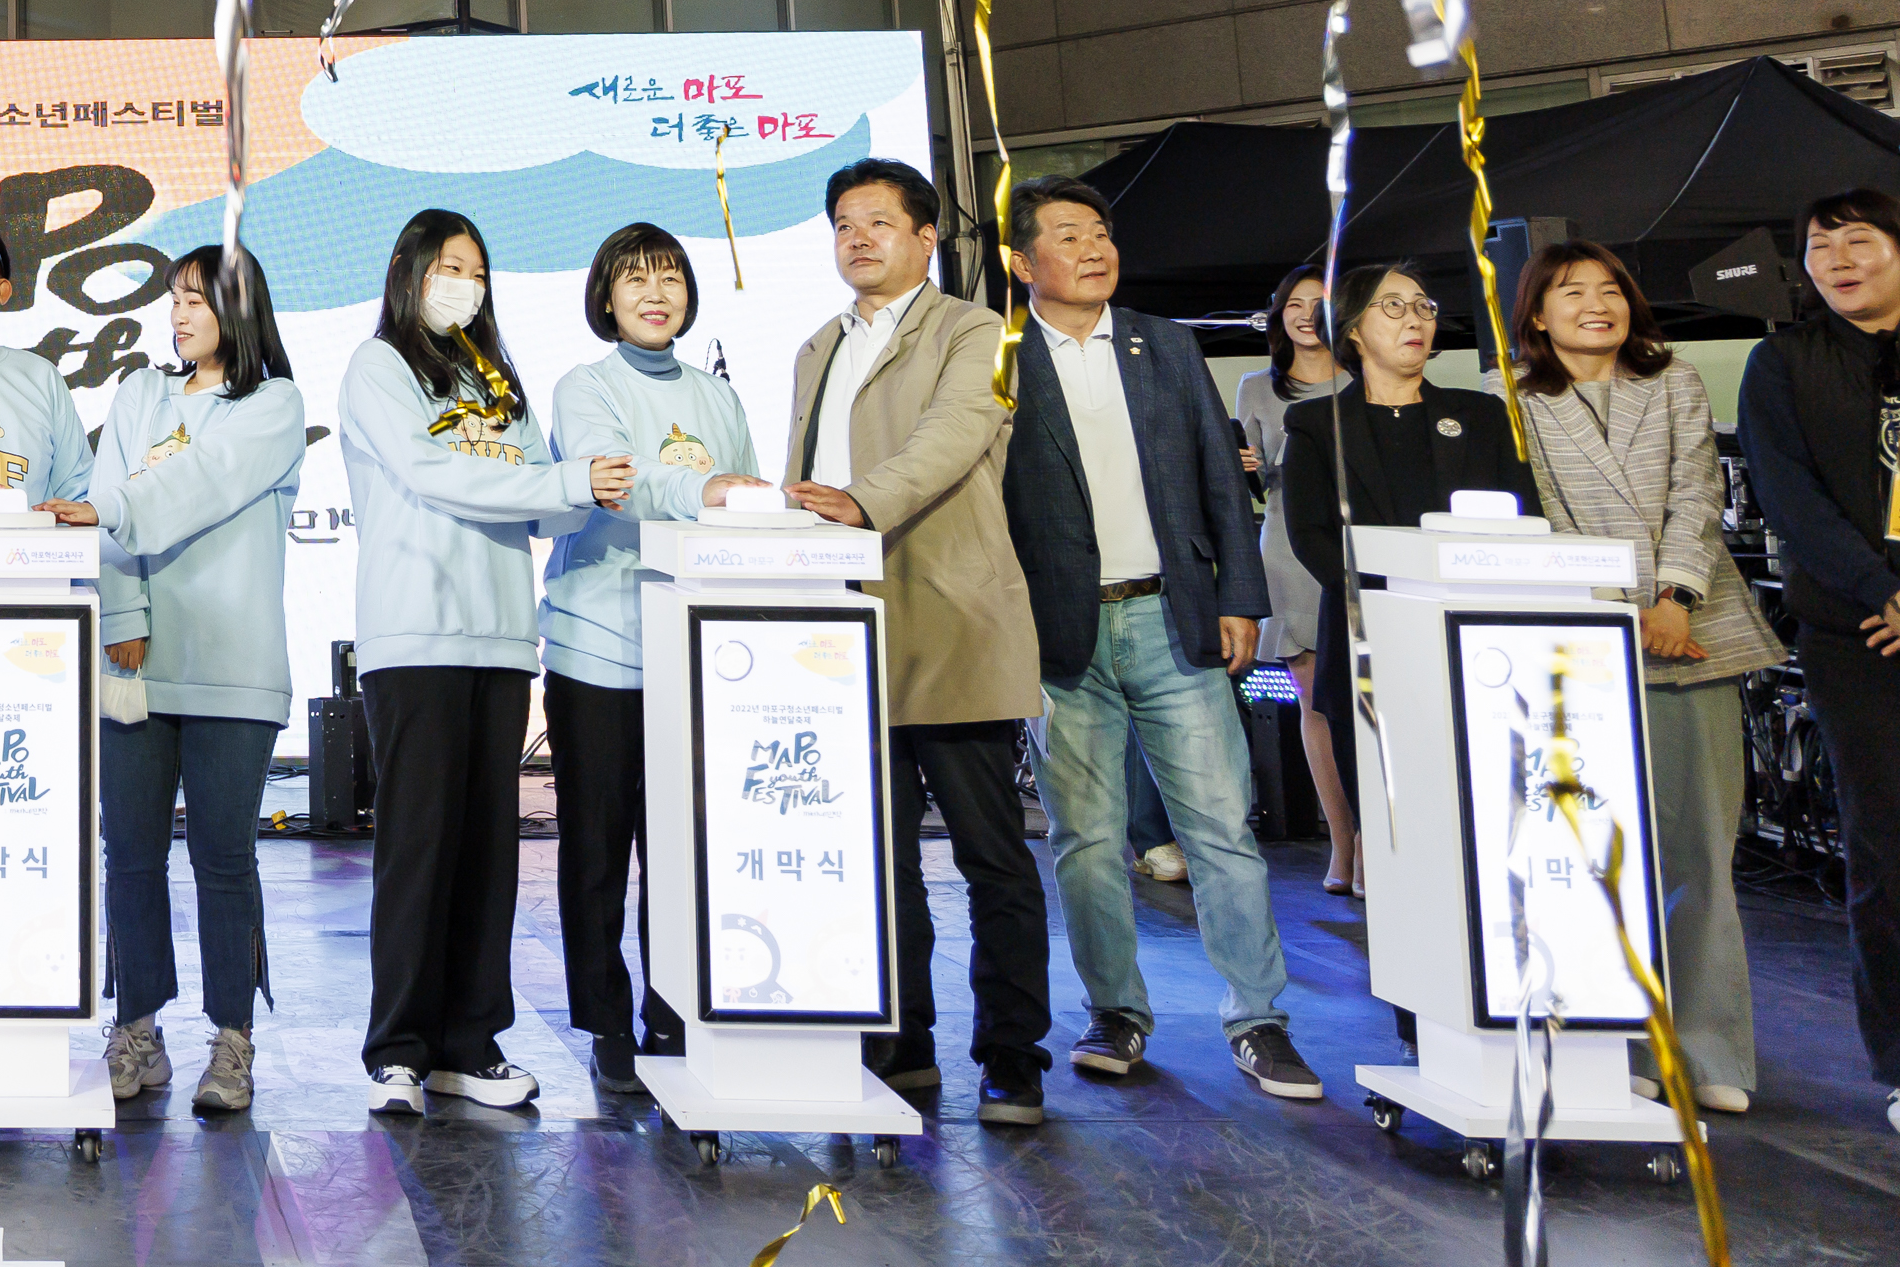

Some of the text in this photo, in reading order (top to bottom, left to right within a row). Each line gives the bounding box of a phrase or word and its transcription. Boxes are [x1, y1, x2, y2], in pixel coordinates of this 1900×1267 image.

[568, 74, 763, 104] 새로운 마포
[651, 112, 835, 142] 더 좋은 마포
[1716, 264, 1758, 281] SHURE
[730, 704, 759, 713] 2022년
[750, 730, 821, 771] MAPO
[741, 763, 844, 815] FESTIVAL
[767, 766, 821, 789] youth
